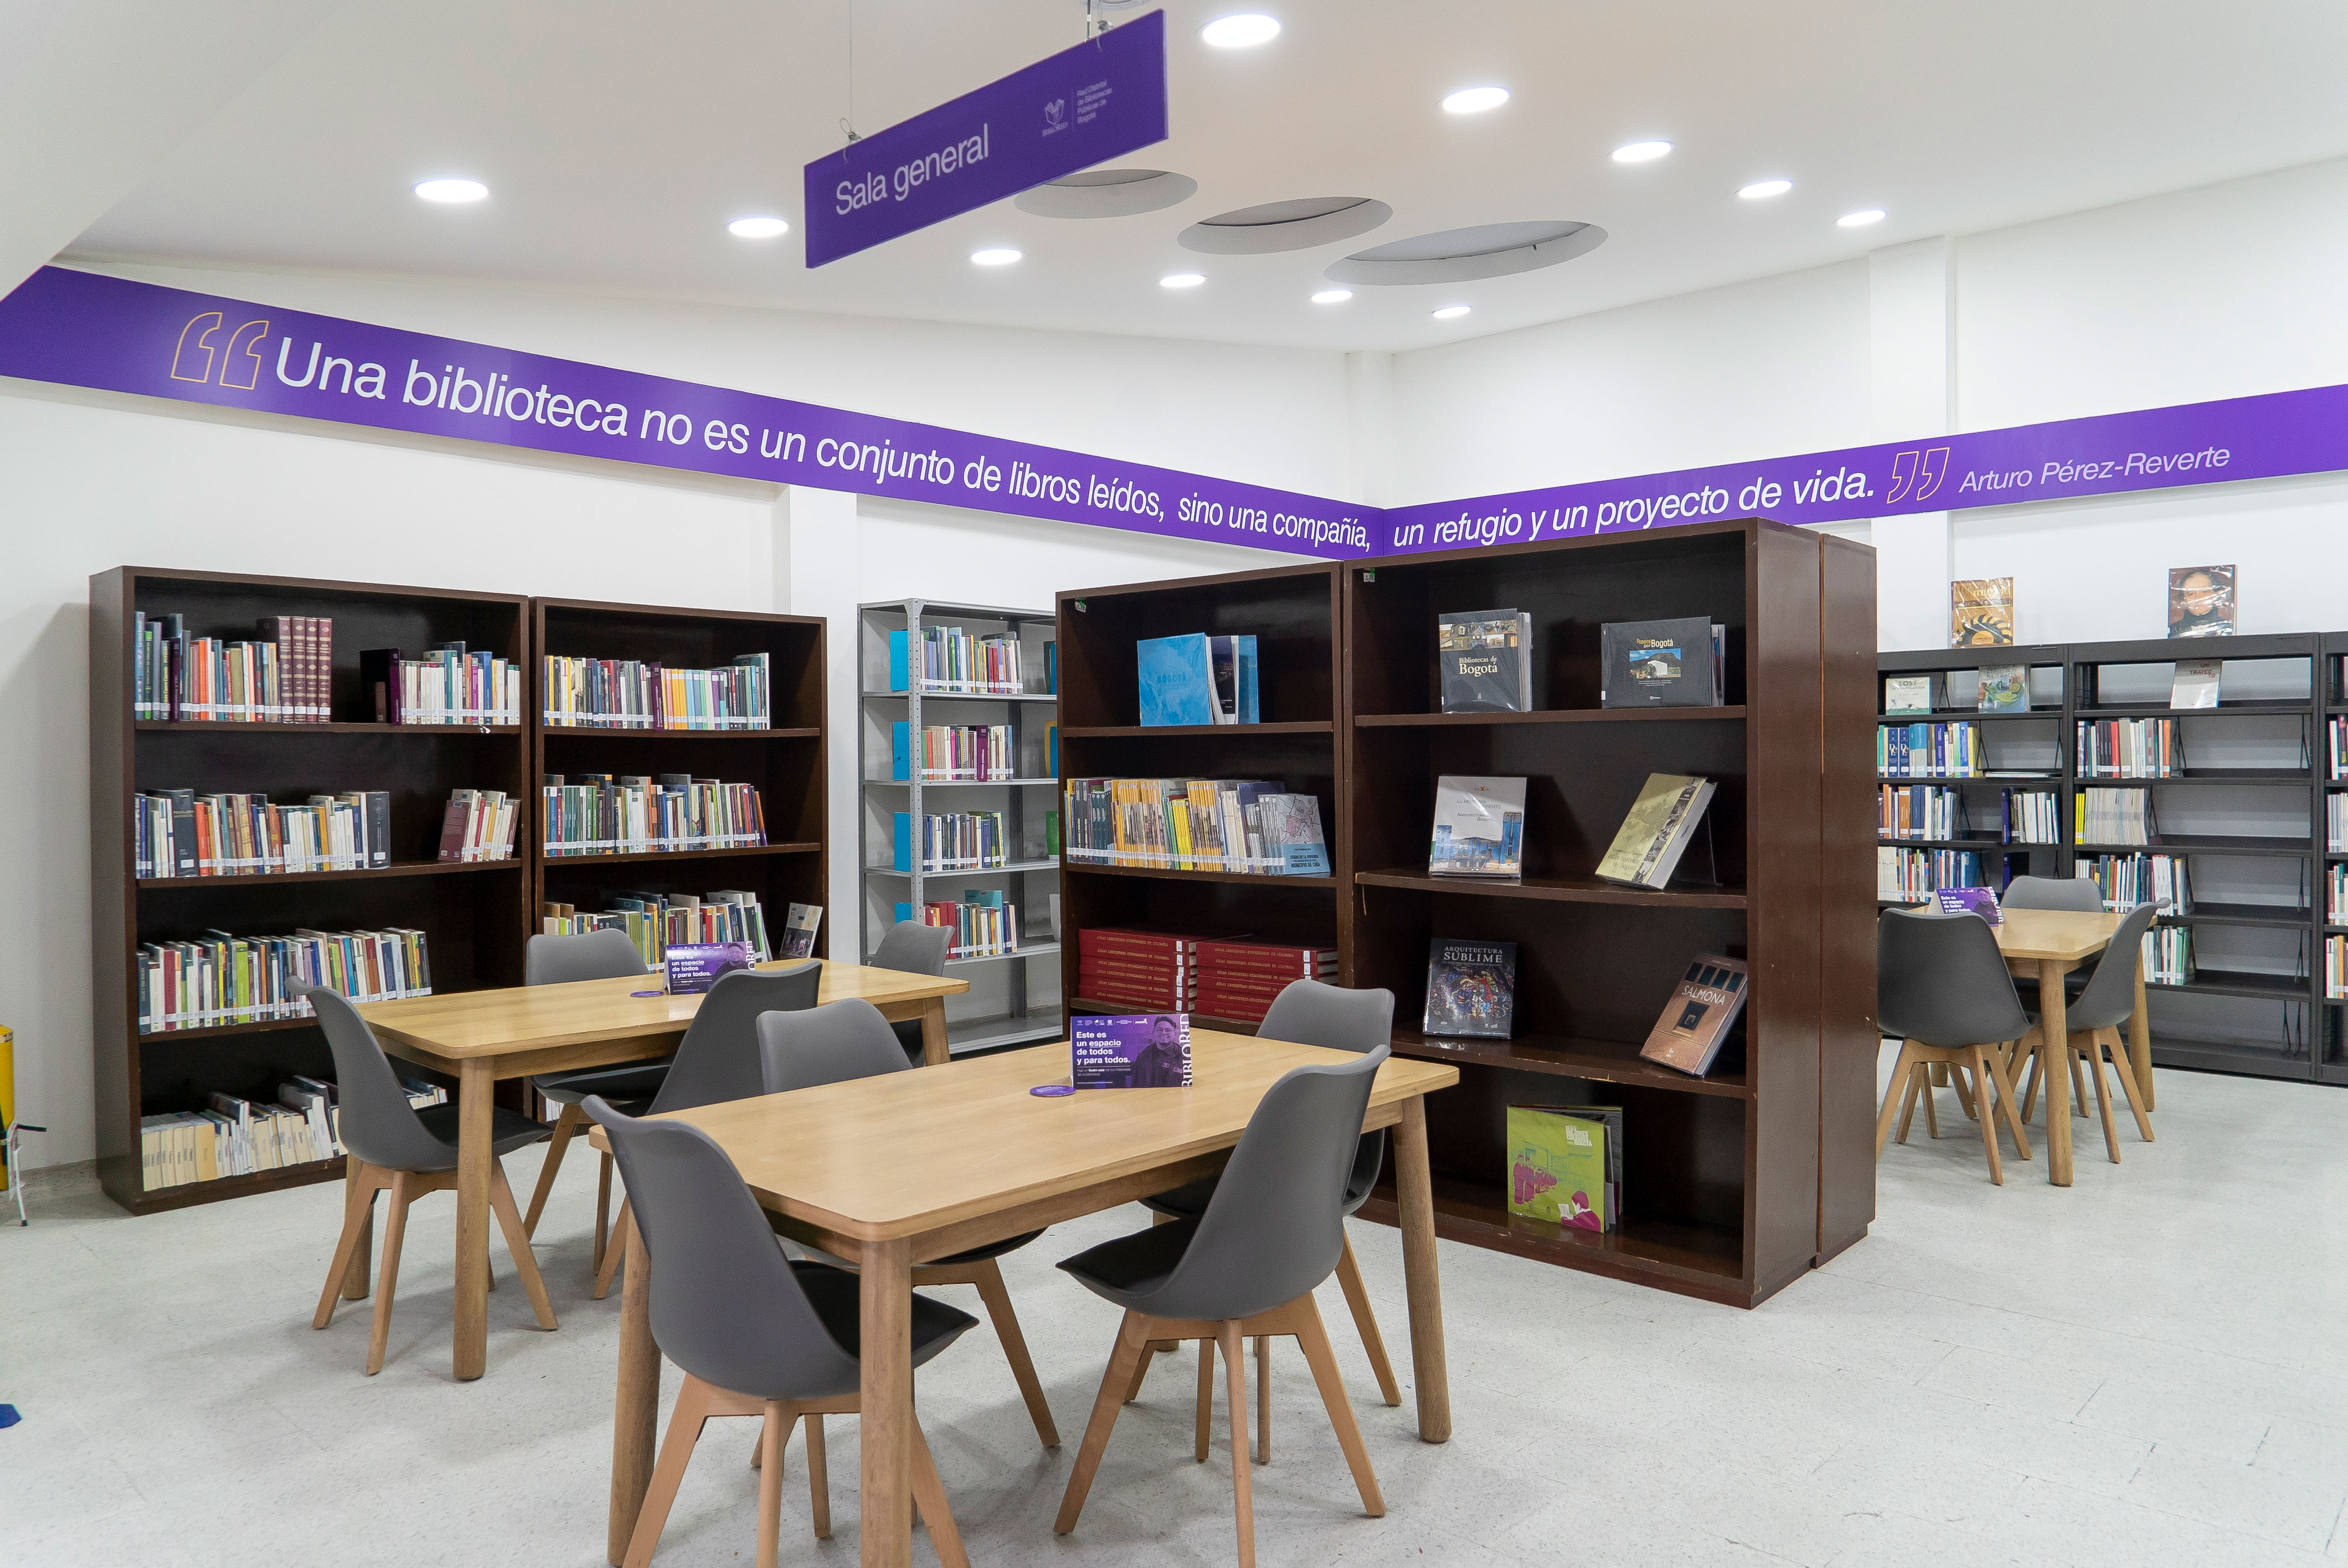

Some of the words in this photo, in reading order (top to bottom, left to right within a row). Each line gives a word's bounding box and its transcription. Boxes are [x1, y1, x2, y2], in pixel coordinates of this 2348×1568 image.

[836, 172, 887, 215] Sala
[894, 123, 988, 202] general
[276, 337, 386, 400] Una
[403, 359, 627, 436] biblioteca
[640, 409, 692, 445] no
[704, 419, 750, 454] es
[760, 429, 806, 462] un
[816, 438, 955, 484] conjunto
[964, 455, 1001, 492] de
[1008, 461, 1081, 504] libros
[1087, 474, 1164, 522] leídos,
[1178, 492, 1223, 526] sino
[1229, 506, 1267, 533] una
[1273, 515, 1371, 551] compañía,
[1958, 470, 2033, 493] Arturo
[2040, 447, 2231, 486] Pérez-Reverte
[1394, 524, 1424, 547] un
[1433, 508, 1522, 546] refugio
[1528, 510, 1547, 541] y
[1552, 506, 1588, 531] un
[1595, 490, 1729, 534] proyecto
[1738, 477, 1782, 510] de
[1793, 466, 1874, 504] vida.
[1651, 638, 1674, 649] Bogotá
[1459, 663, 1498, 677] Bogotá
[1444, 946, 1503, 955] ARQUITECTURA
[1444, 952, 1503, 963] SUBLIME
[1681, 985, 1726, 1005] SALMONA
[1089, 1039, 1121, 1048] espacio
[1077, 1058, 1082, 1066] y
[1084, 1057, 1103, 1065] para
